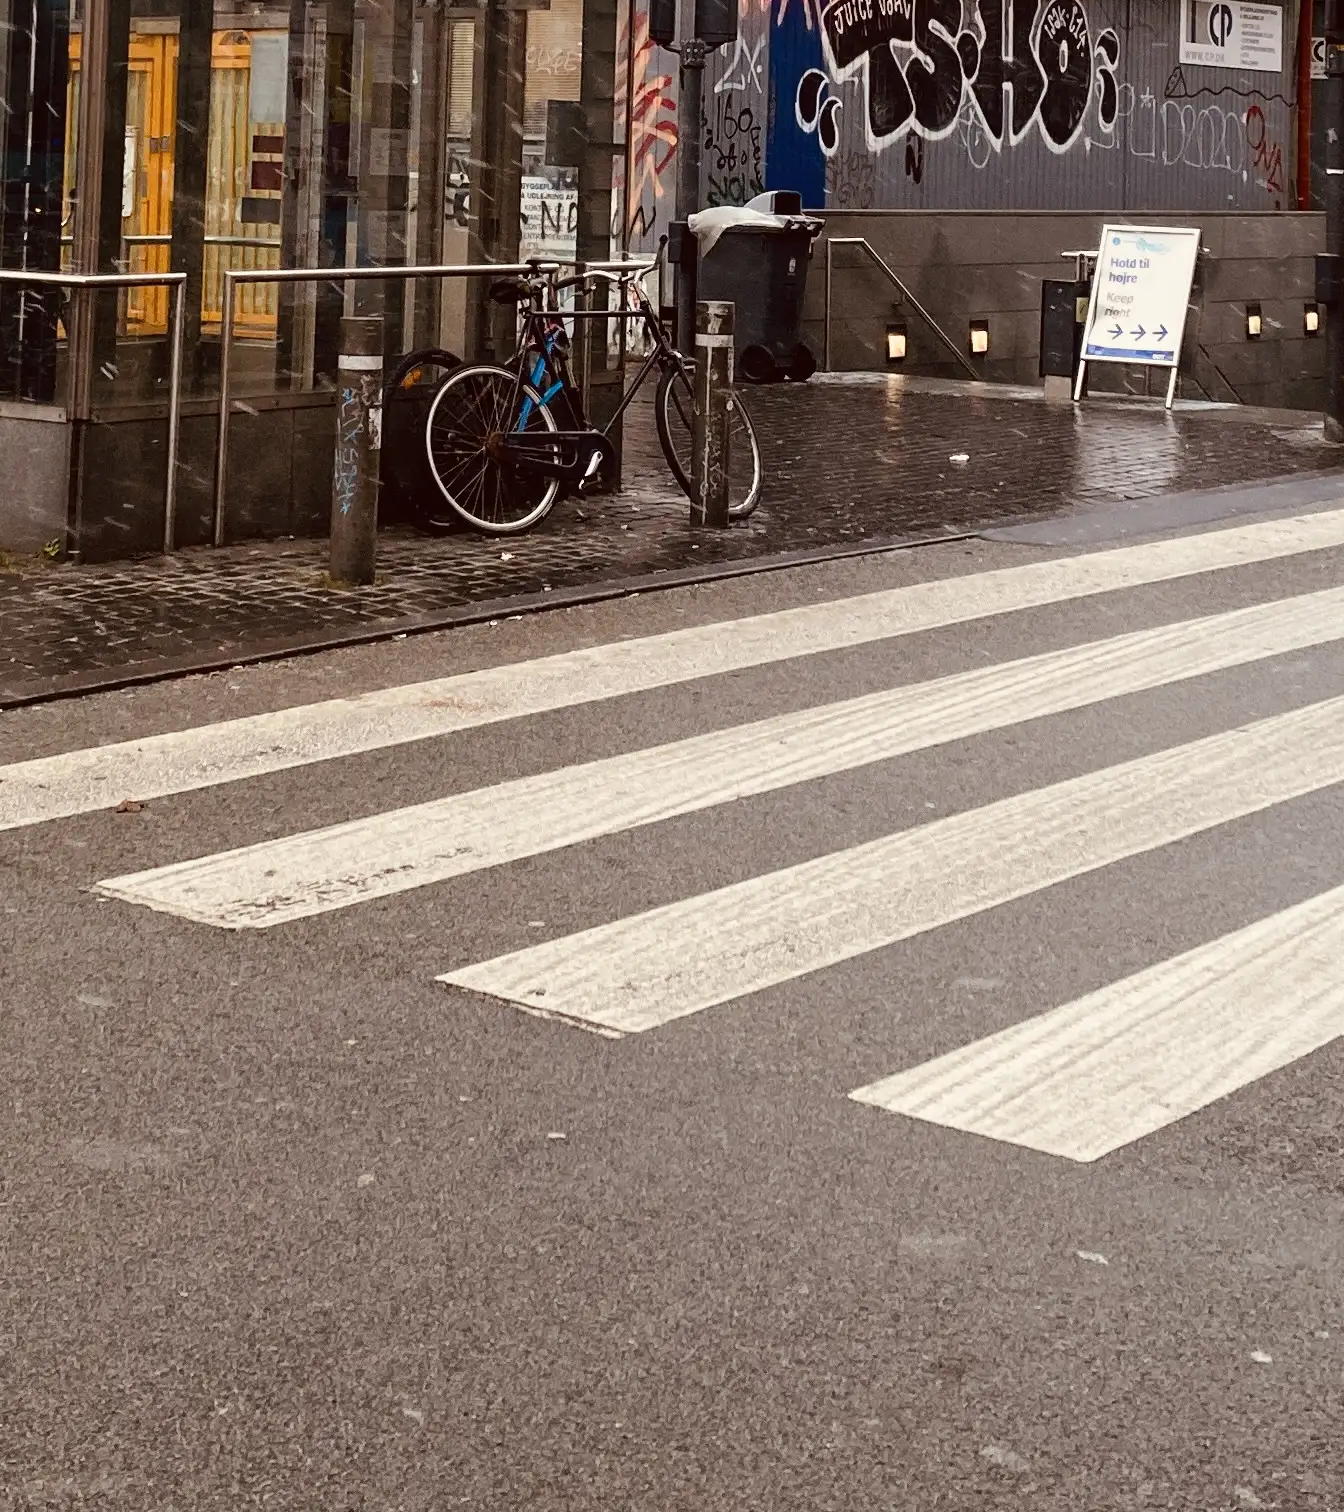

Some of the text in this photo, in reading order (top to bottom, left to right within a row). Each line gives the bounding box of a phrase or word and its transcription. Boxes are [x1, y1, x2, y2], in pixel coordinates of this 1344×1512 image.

[1110, 257, 1150, 269] Hold til
[1108, 272, 1138, 285] højre
[1106, 291, 1134, 305] Keep
